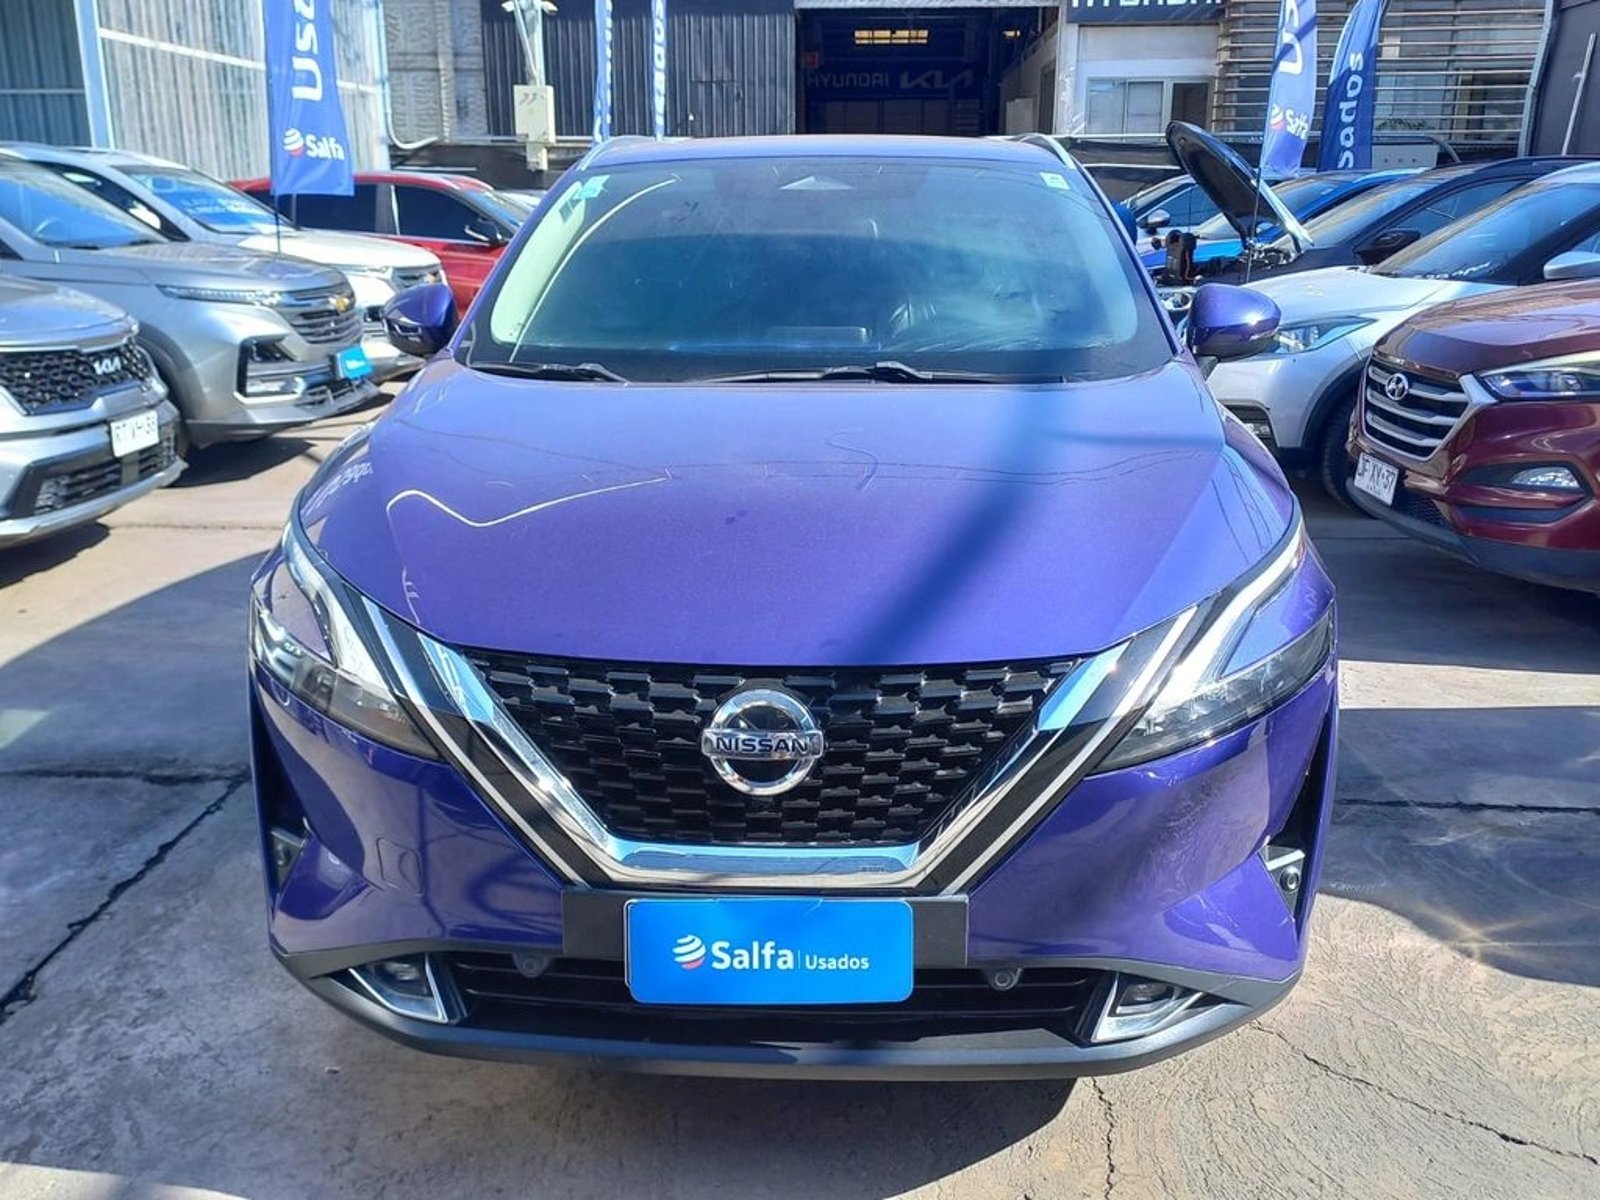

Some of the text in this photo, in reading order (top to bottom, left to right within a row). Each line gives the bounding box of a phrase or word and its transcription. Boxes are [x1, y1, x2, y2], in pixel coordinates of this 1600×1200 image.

[807, 69, 975, 89] HYUNDAI KIA
[305, 133, 346, 161] Salfa
[716, 737, 808, 753] NISSAN
[711, 940, 870, 970] Salfa Usados
